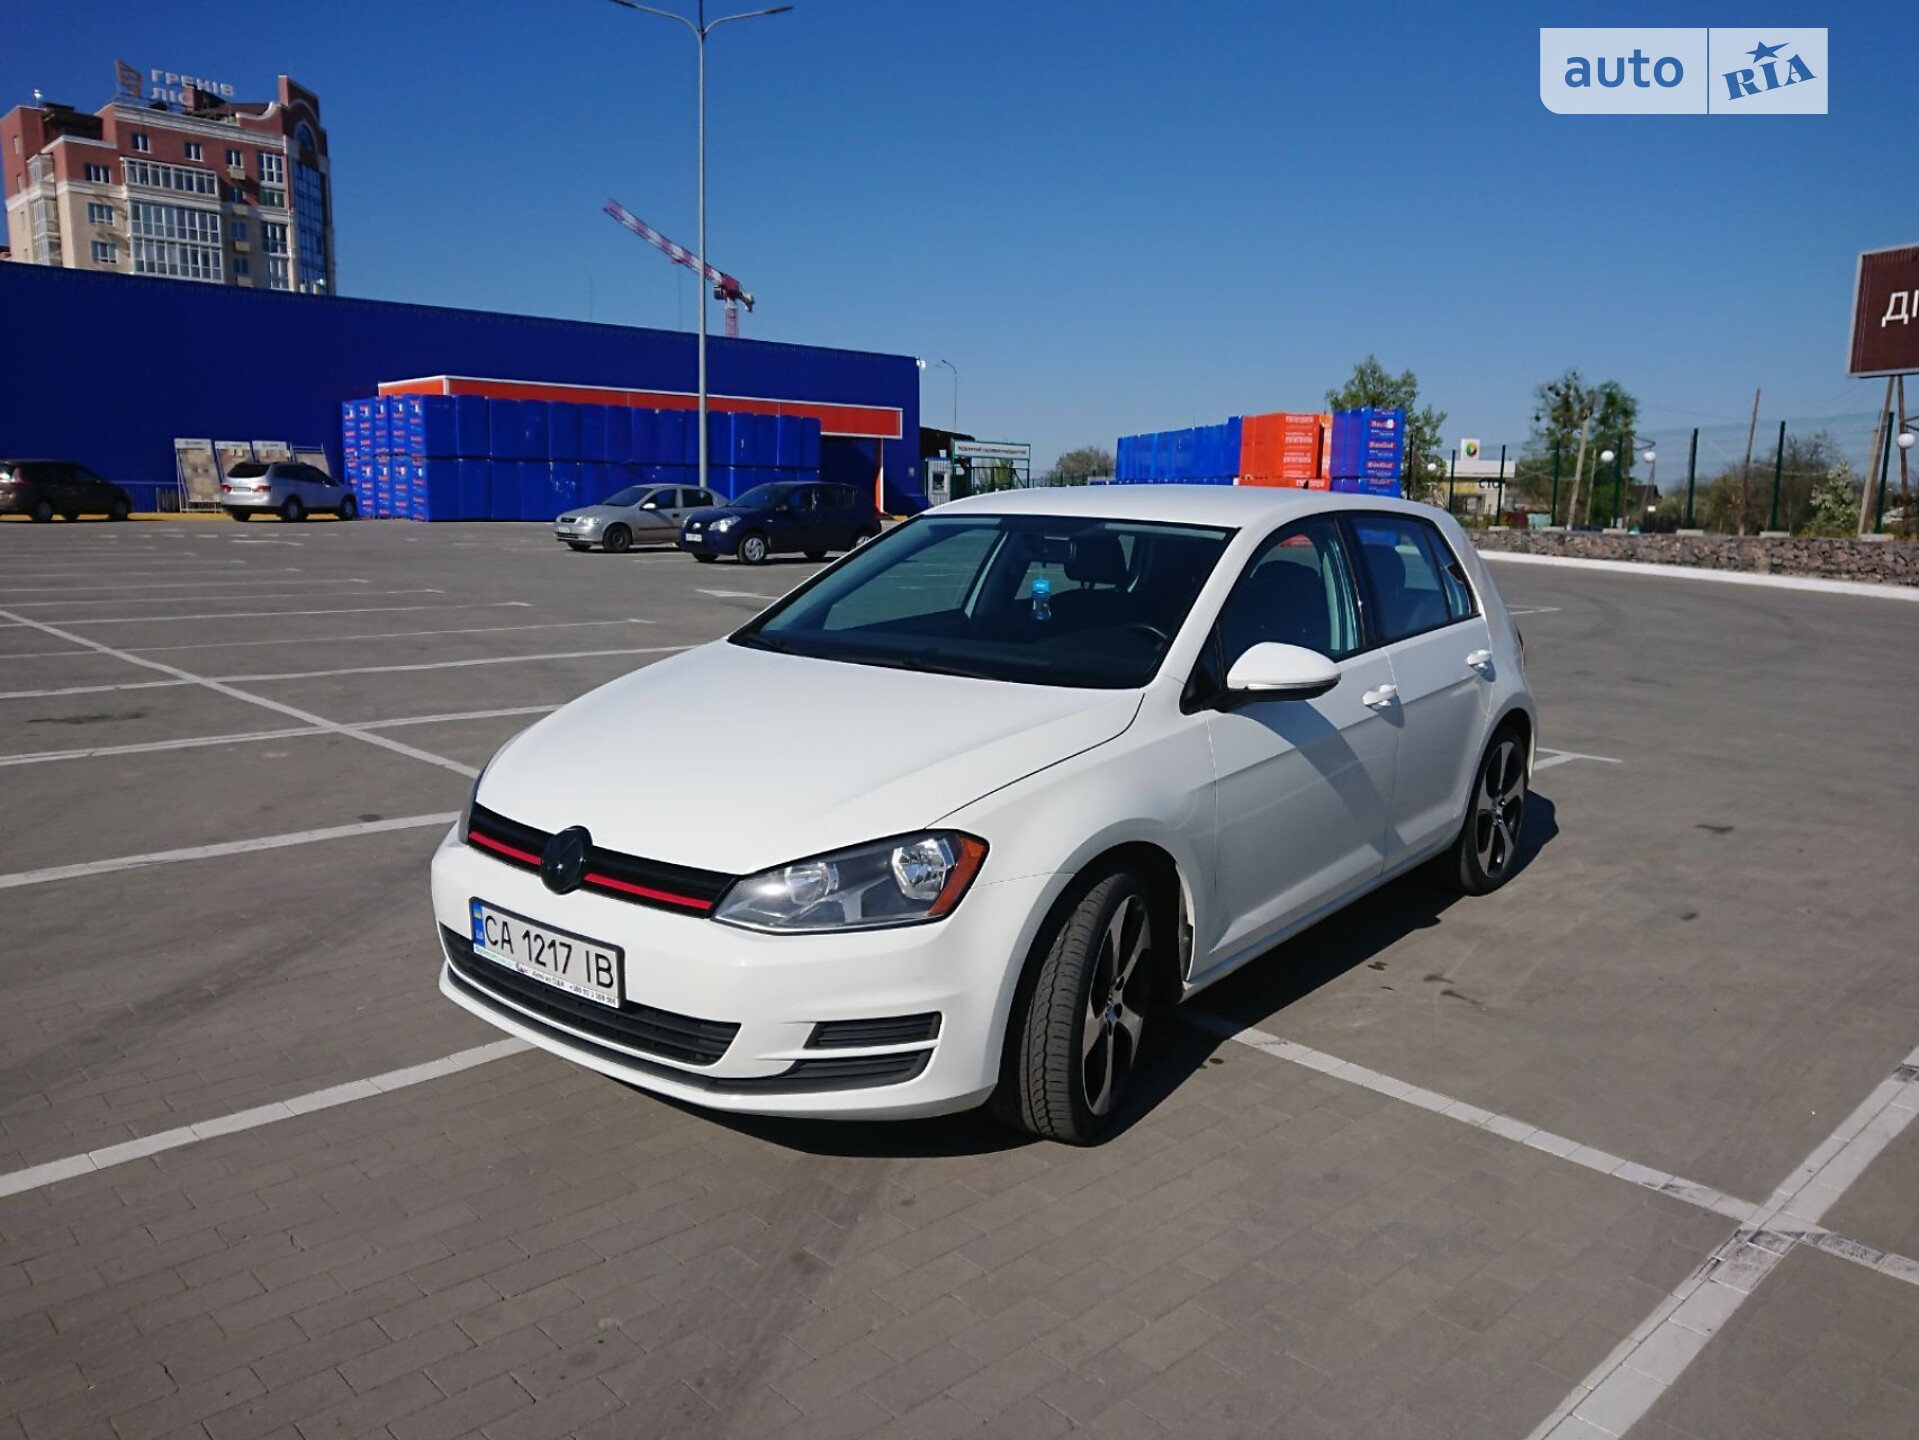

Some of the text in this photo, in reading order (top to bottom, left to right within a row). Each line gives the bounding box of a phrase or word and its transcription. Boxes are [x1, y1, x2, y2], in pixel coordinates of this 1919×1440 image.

[485, 915, 514, 954] CA
[522, 929, 572, 974] 1217
[586, 950, 614, 989] IB
